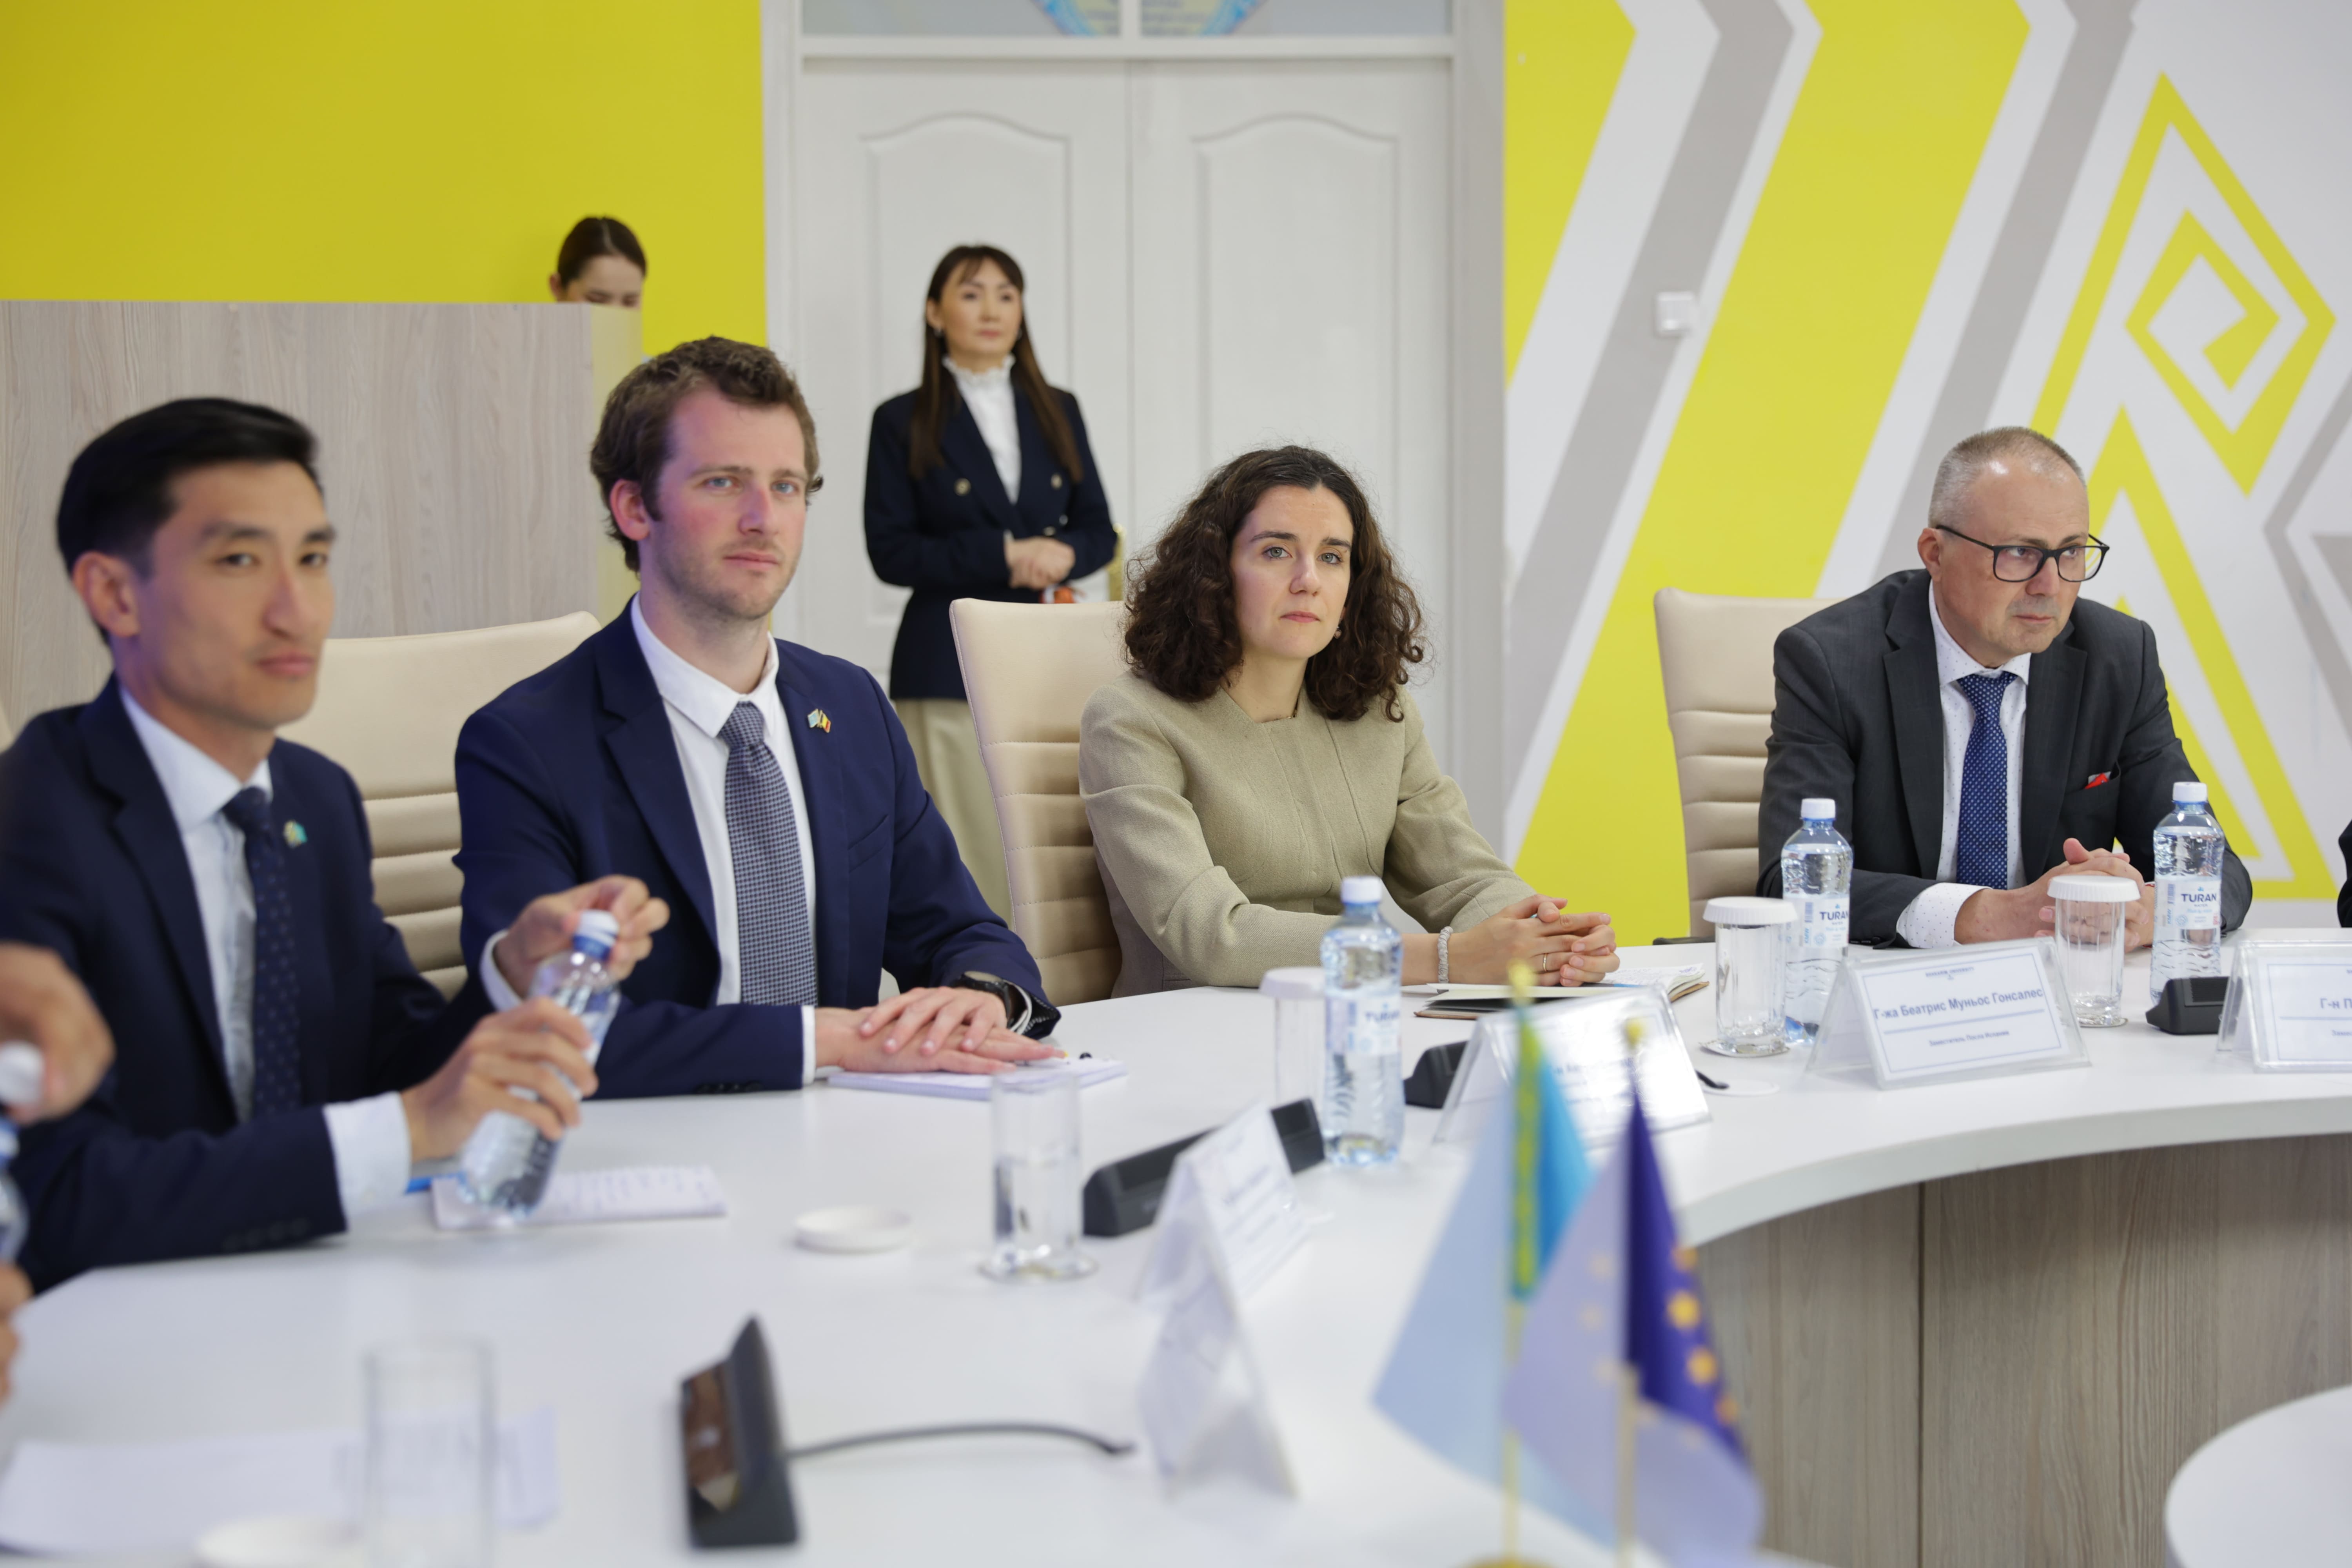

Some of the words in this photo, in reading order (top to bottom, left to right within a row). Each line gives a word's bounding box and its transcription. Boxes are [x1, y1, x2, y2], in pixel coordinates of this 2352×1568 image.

[2181, 893, 2216, 902] TURAN
[1873, 1008, 1898, 1019] Г-жа
[1900, 1002, 1946, 1016] Беатрис
[1948, 998, 1990, 1011] Муньос
[1991, 989, 2043, 1004] Гонсалес
[2320, 998, 2340, 1009] Г-н
